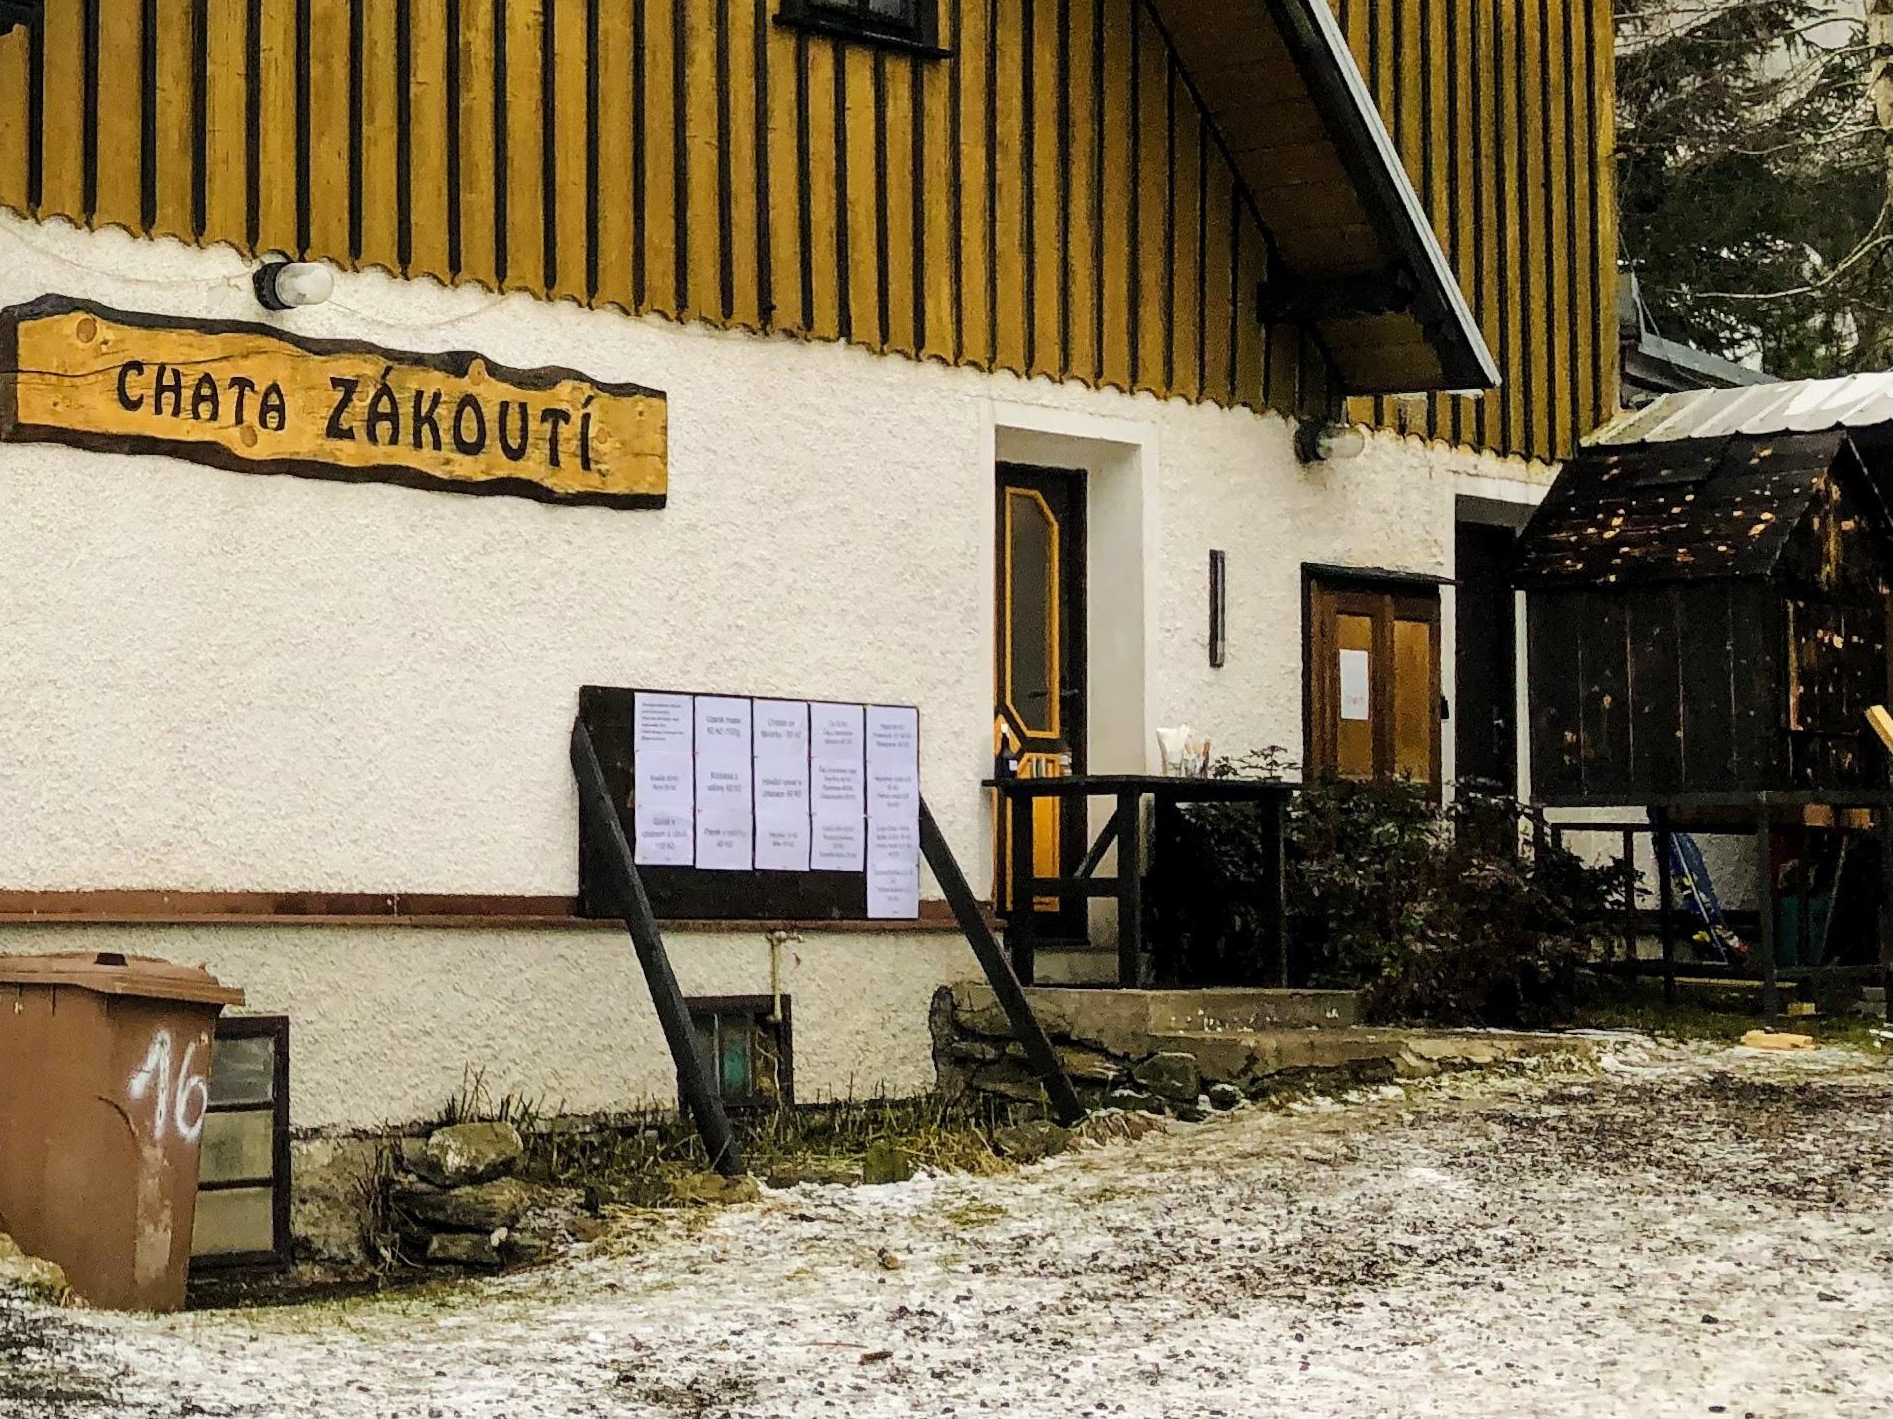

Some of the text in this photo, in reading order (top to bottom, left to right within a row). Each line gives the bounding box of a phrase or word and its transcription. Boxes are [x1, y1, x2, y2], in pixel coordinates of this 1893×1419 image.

[116, 359, 593, 470] CHATA ZÁKOUTÍ
[129, 1028, 208, 1143] 16
